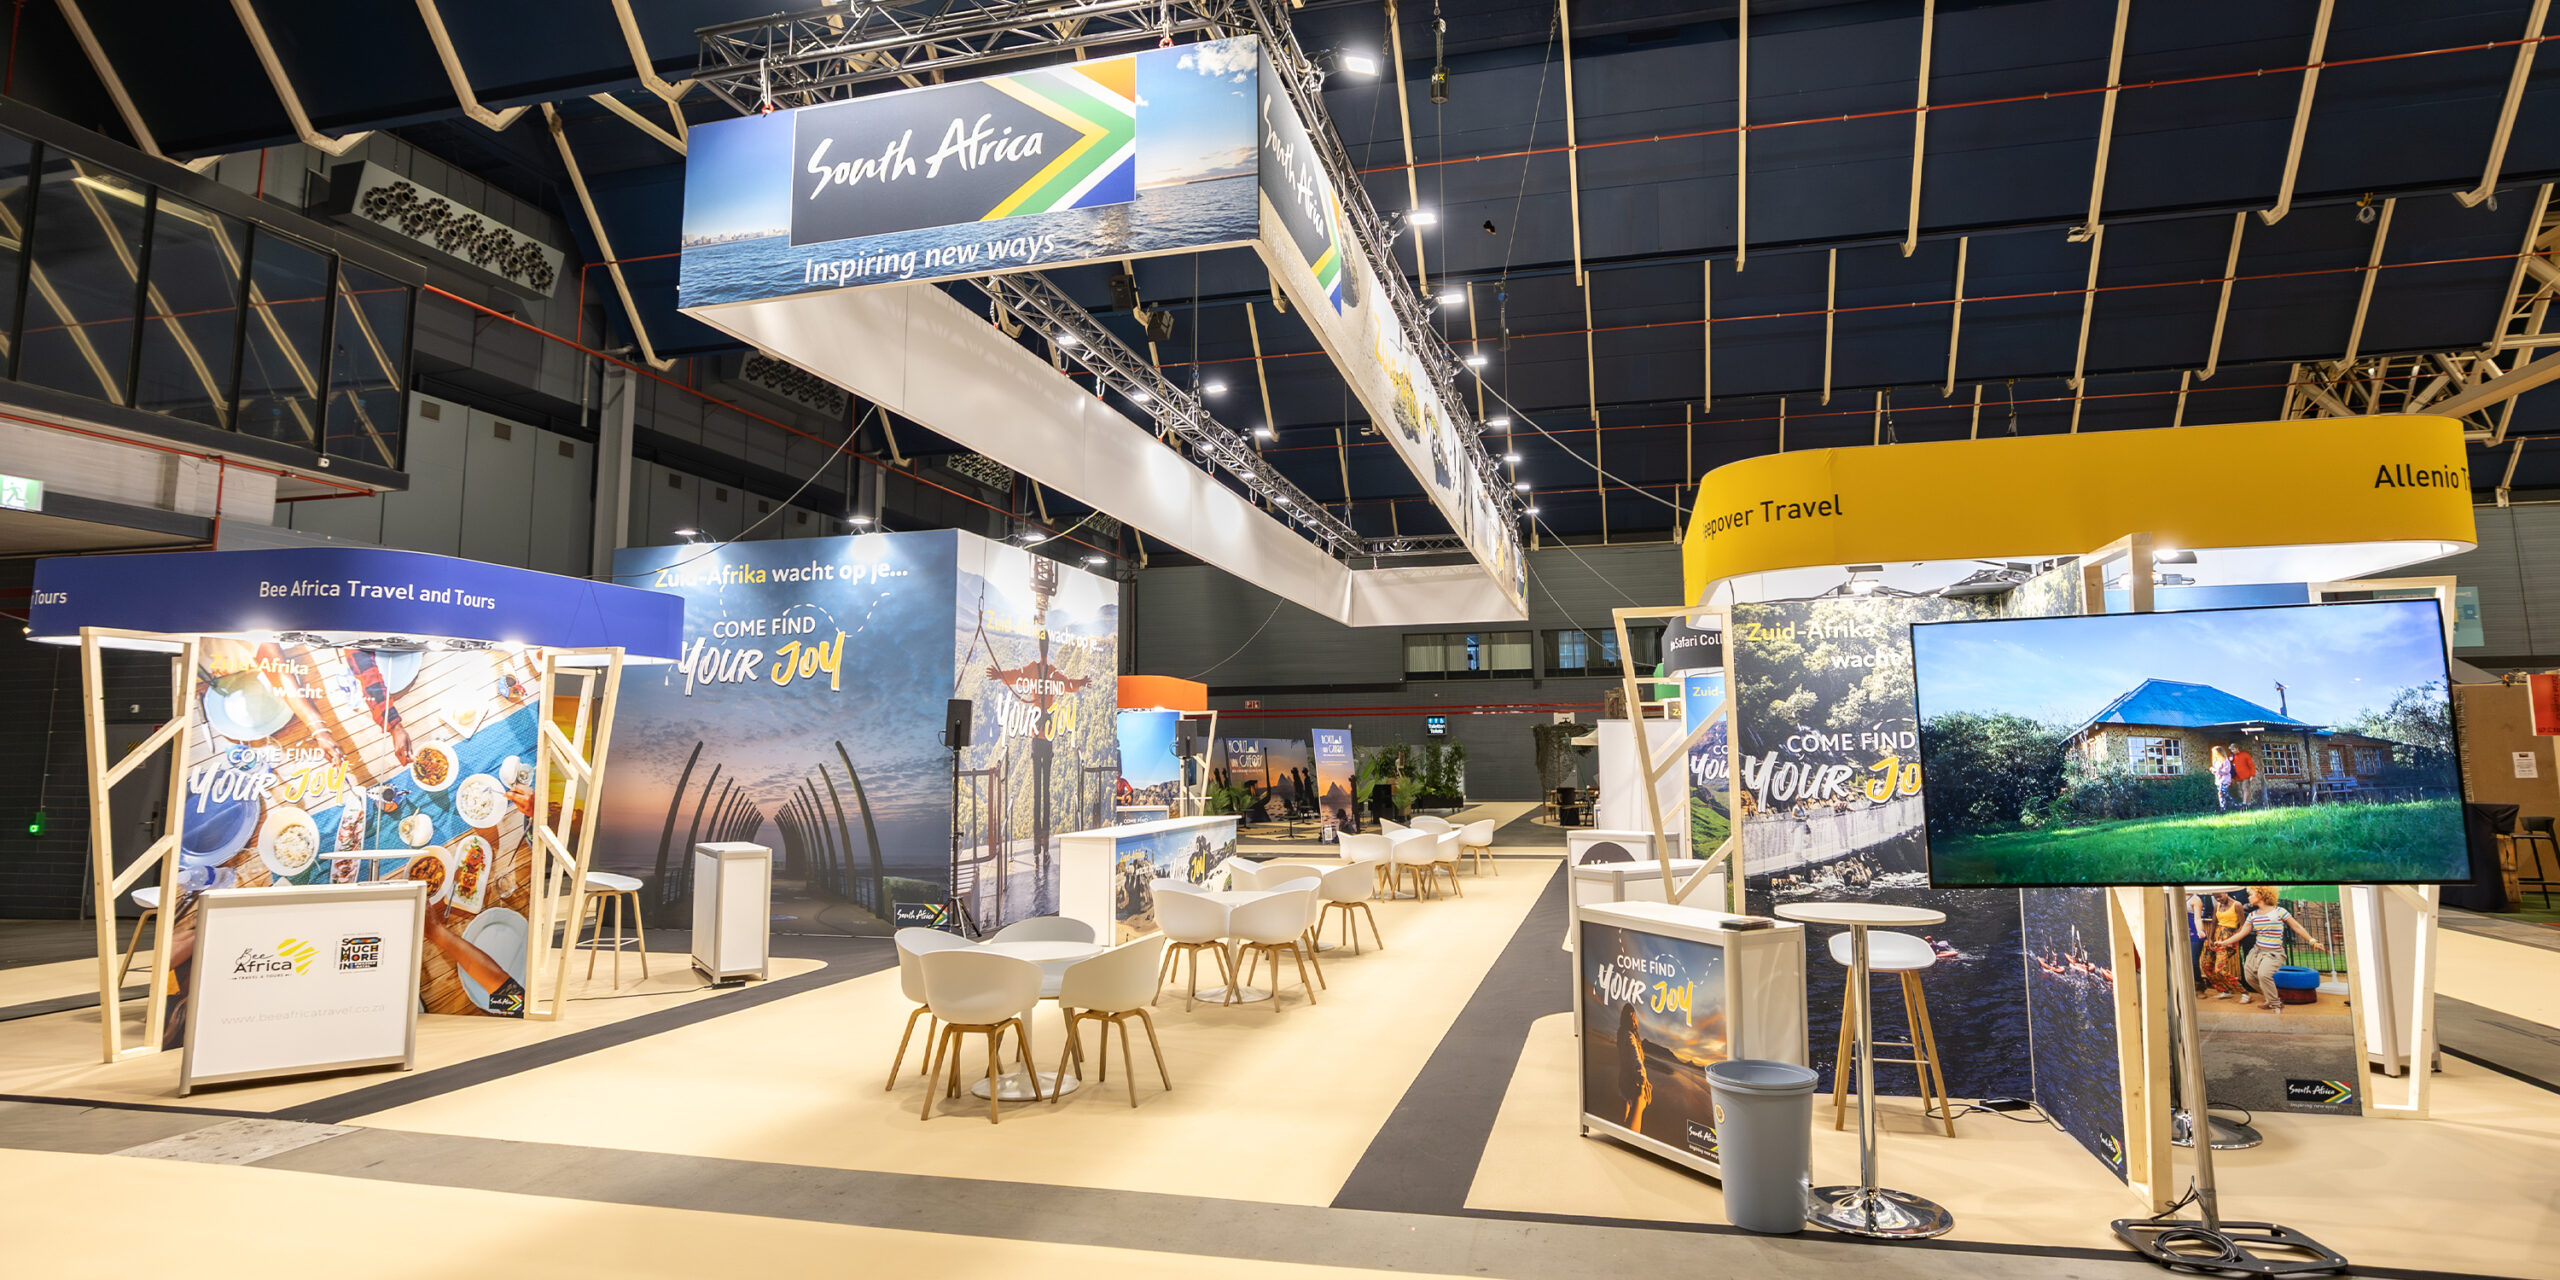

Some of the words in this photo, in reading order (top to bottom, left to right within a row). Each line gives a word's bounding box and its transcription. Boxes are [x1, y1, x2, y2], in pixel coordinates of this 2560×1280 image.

[807, 129, 917, 200] South
[925, 113, 1044, 179] Africa
[1264, 93, 1296, 190] South
[1297, 162, 1324, 239] Africa
[804, 248, 917, 287] Inspiring
[925, 243, 980, 269] new
[987, 233, 1058, 264] ways
[2374, 463, 2459, 489] Allenio
[1760, 493, 1843, 523] Travel
[654, 564, 767, 588] Zuid-Afrika
[772, 560, 834, 583] wacht
[839, 563, 866, 585] op
[34, 589, 68, 605] Tours
[259, 581, 288, 598] Bee
[290, 580, 341, 597] Africa
[347, 580, 414, 601] Travel
[419, 588, 451, 604] and
[455, 589, 496, 610] Tours
[713, 618, 767, 639] COME
[771, 616, 817, 636] FIND
[1747, 621, 1875, 642] Zuid-Afrika
[1674, 634, 1698, 649] Safari
[677, 637, 764, 697] YOUR
[771, 630, 846, 692] JOY
[1016, 677, 1044, 695] COME
[1044, 679, 1066, 696] FIND
[997, 691, 1042, 748] YOUR
[1044, 697, 1078, 748] JOY
[1786, 733, 1854, 753] COME
[1861, 731, 1917, 750] FIND
[228, 748, 281, 764] COME
[286, 747, 325, 763] FIND
[189, 762, 278, 814] YOUR
[284, 760, 349, 807] JOY
[1743, 750, 1854, 814] YOUR
[233, 959, 293, 974] Africa
[234, 947, 274, 966] Bee
[1616, 954, 1648, 973] COME
[1649, 960, 1676, 978] FIND
[1598, 963, 1647, 1006] YOUR
[1650, 980, 1694, 1028] JOY
[2288, 1083, 2311, 1095] South
[2312, 1084, 2336, 1096] Africa
